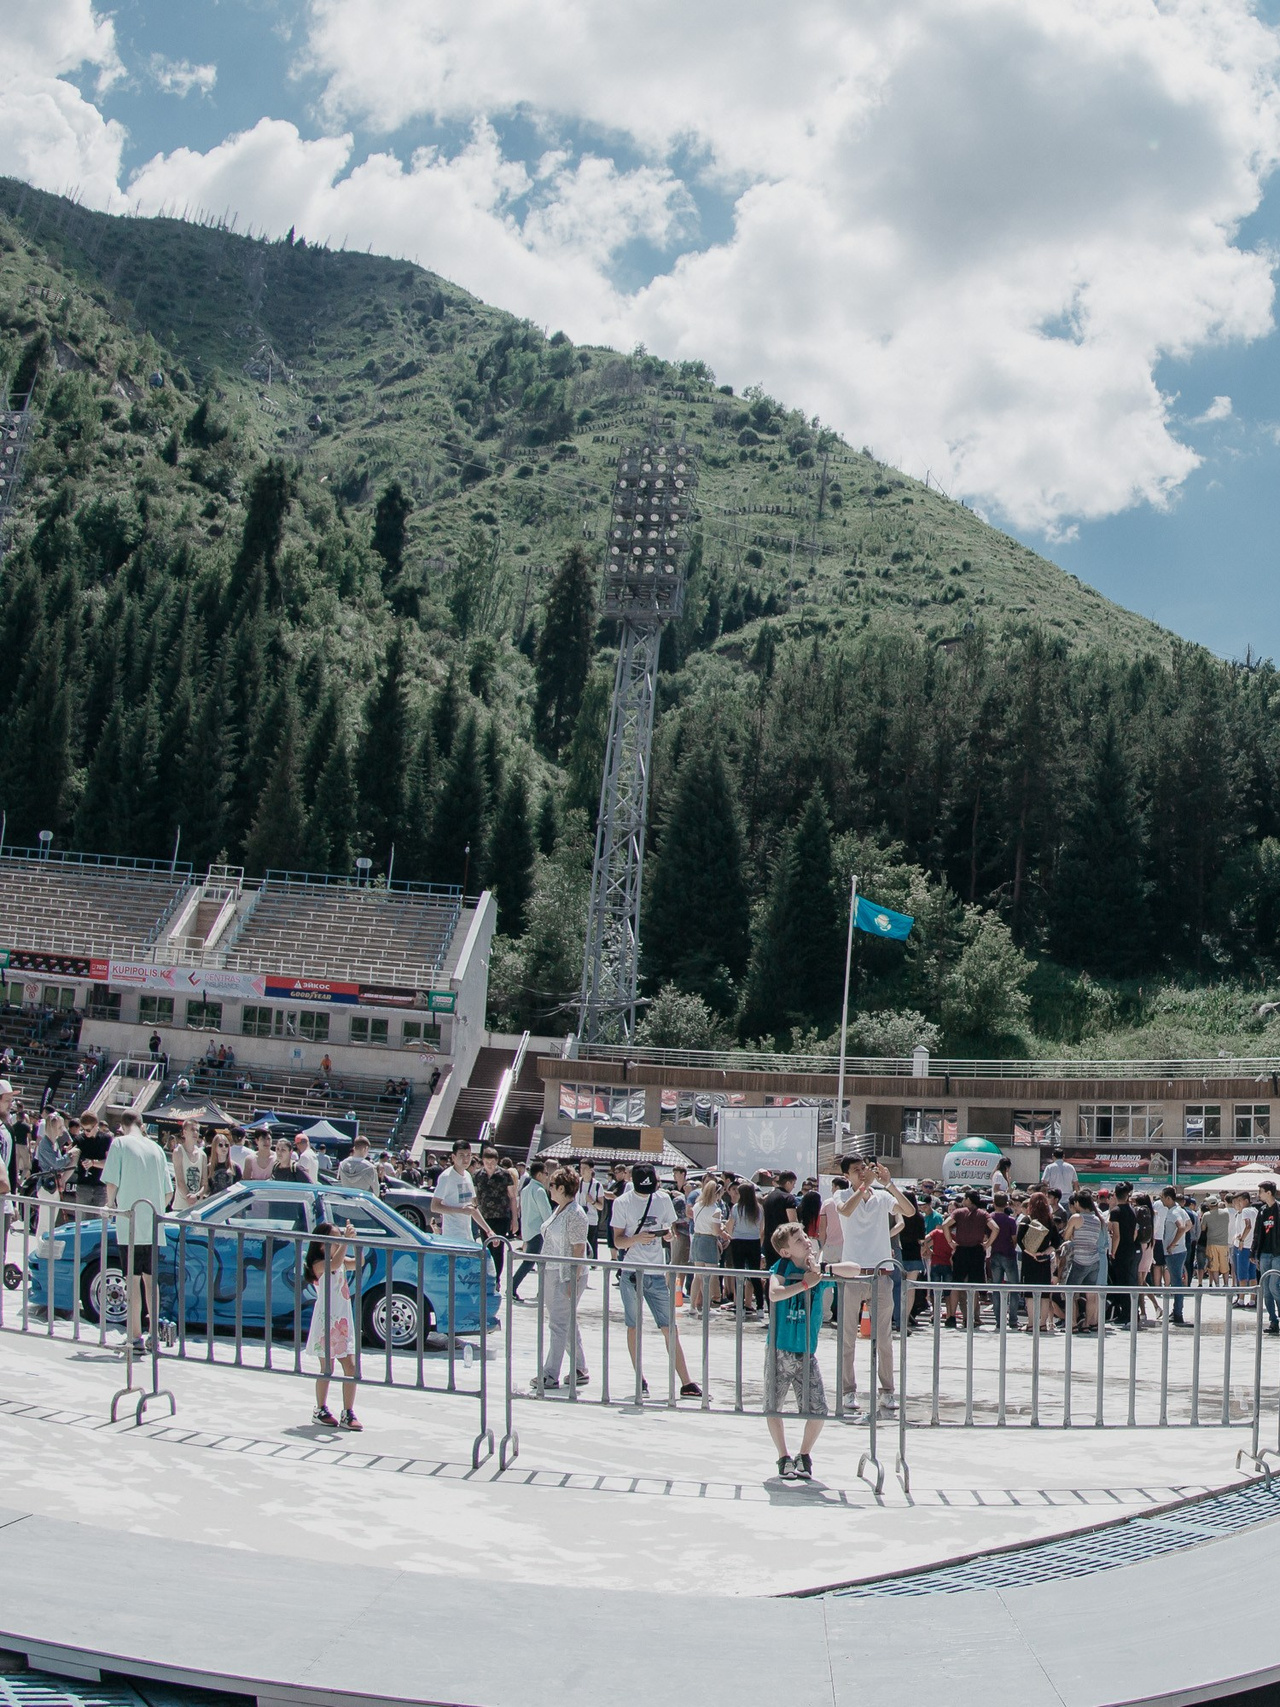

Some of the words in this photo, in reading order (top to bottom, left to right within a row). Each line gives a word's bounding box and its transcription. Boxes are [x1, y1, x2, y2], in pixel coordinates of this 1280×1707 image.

[112, 965, 172, 978] KUPIPOLIS.KZ
[204, 973, 240, 983] CENTRAS
[205, 981, 239, 990] INSURANCE
[302, 982, 330, 990] ЭЙКОС
[290, 990, 332, 1000] GOODYEAR
[962, 1158, 988, 1167] Castrol
[949, 1170, 992, 1180] MAGNATE
